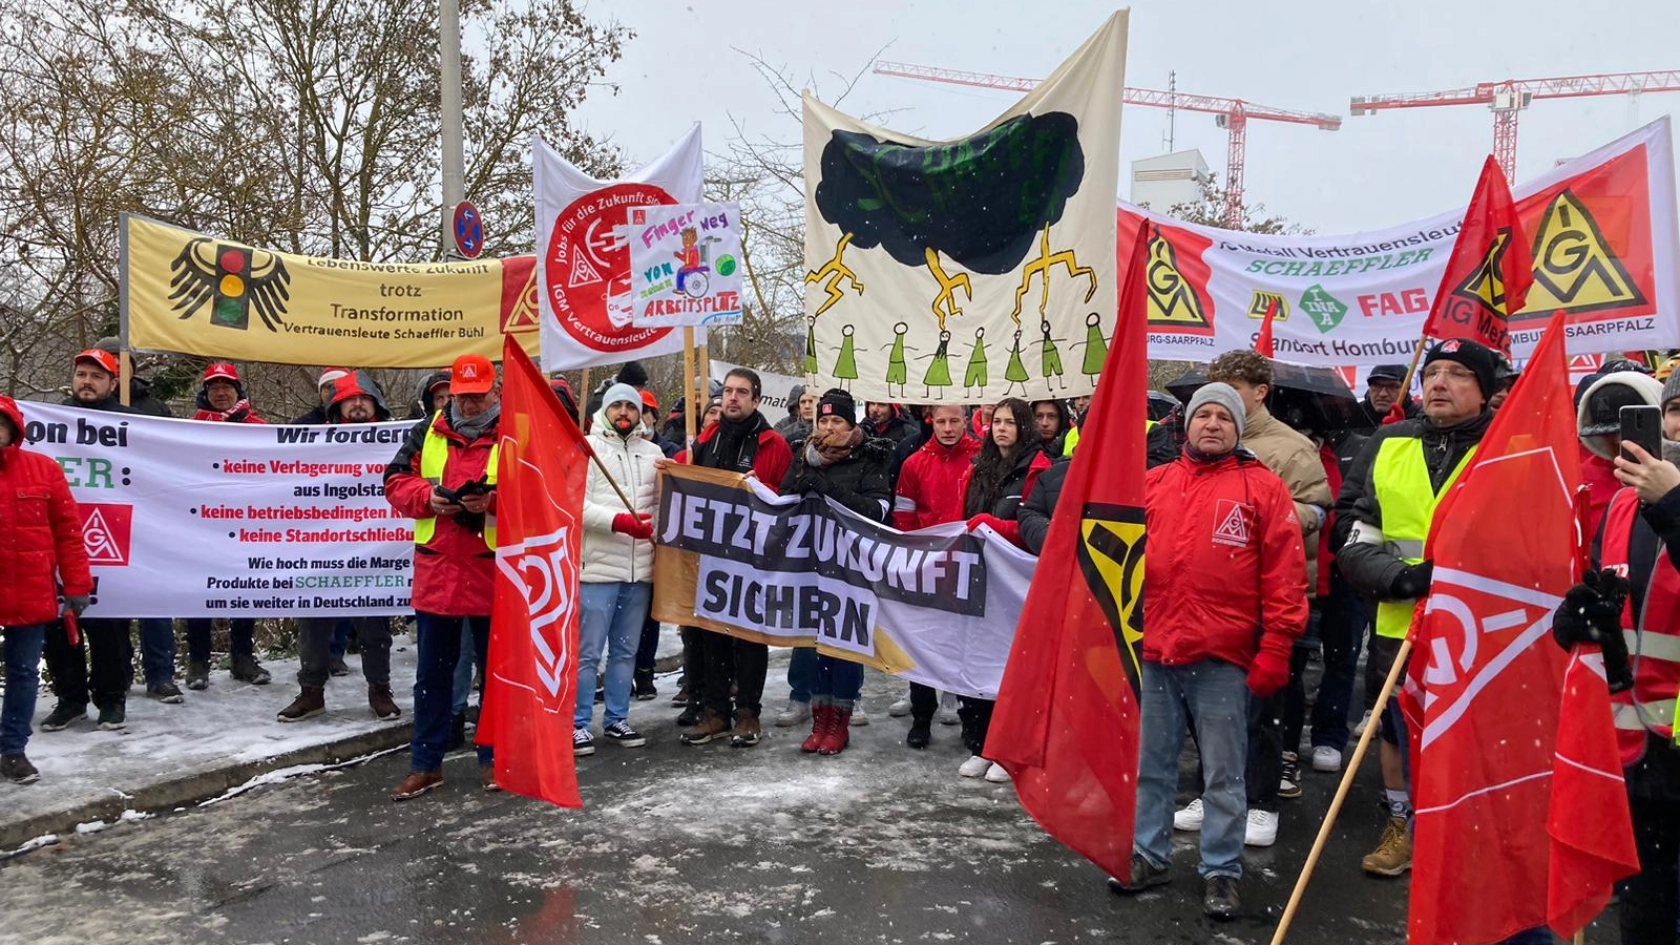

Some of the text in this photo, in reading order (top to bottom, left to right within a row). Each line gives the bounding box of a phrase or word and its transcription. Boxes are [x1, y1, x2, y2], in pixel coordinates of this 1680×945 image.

[555, 234, 568, 265] Jobs
[562, 219, 577, 234] für
[577, 203, 596, 220] die
[597, 191, 645, 210] Zukunft
[641, 210, 695, 249] Finger
[1245, 247, 1435, 277] SCHAEFFLER
[380, 283, 422, 297] trotz
[552, 284, 570, 312] IGM
[331, 303, 464, 322] Transformation
[1357, 288, 1430, 318] FAG
[1443, 297, 1474, 325] IG
[284, 322, 485, 340] Vertrauensleute Schaeffler Bühl
[1332, 337, 1436, 357] Homburg
[77, 418, 129, 447] bei
[277, 427, 320, 443] Wir
[223, 460, 266, 474] keine
[269, 460, 363, 477] Verlagerung
[294, 483, 385, 500] aus Ingolsta
[201, 505, 244, 519] keine
[247, 505, 387, 522] betriebsbedingten
[239, 528, 415, 542] keine Standortschließu
[661, 491, 980, 601] JETZT ZUKUNFT
[248, 557, 273, 569] Wie
[276, 557, 307, 569] hoch
[311, 559, 344, 569] muss
[347, 556, 367, 568] die
[370, 557, 410, 571] Marge
[207, 577, 269, 589] Produkte
[272, 577, 293, 588] bei
[295, 575, 405, 588] SCHAEFFLER
[206, 598, 227, 608] um
[230, 597, 249, 608] sie
[252, 596, 295, 608] weiter
[298, 597, 310, 608] in
[313, 595, 394, 608] Deutschland
[702, 569, 870, 647] SICHERN
